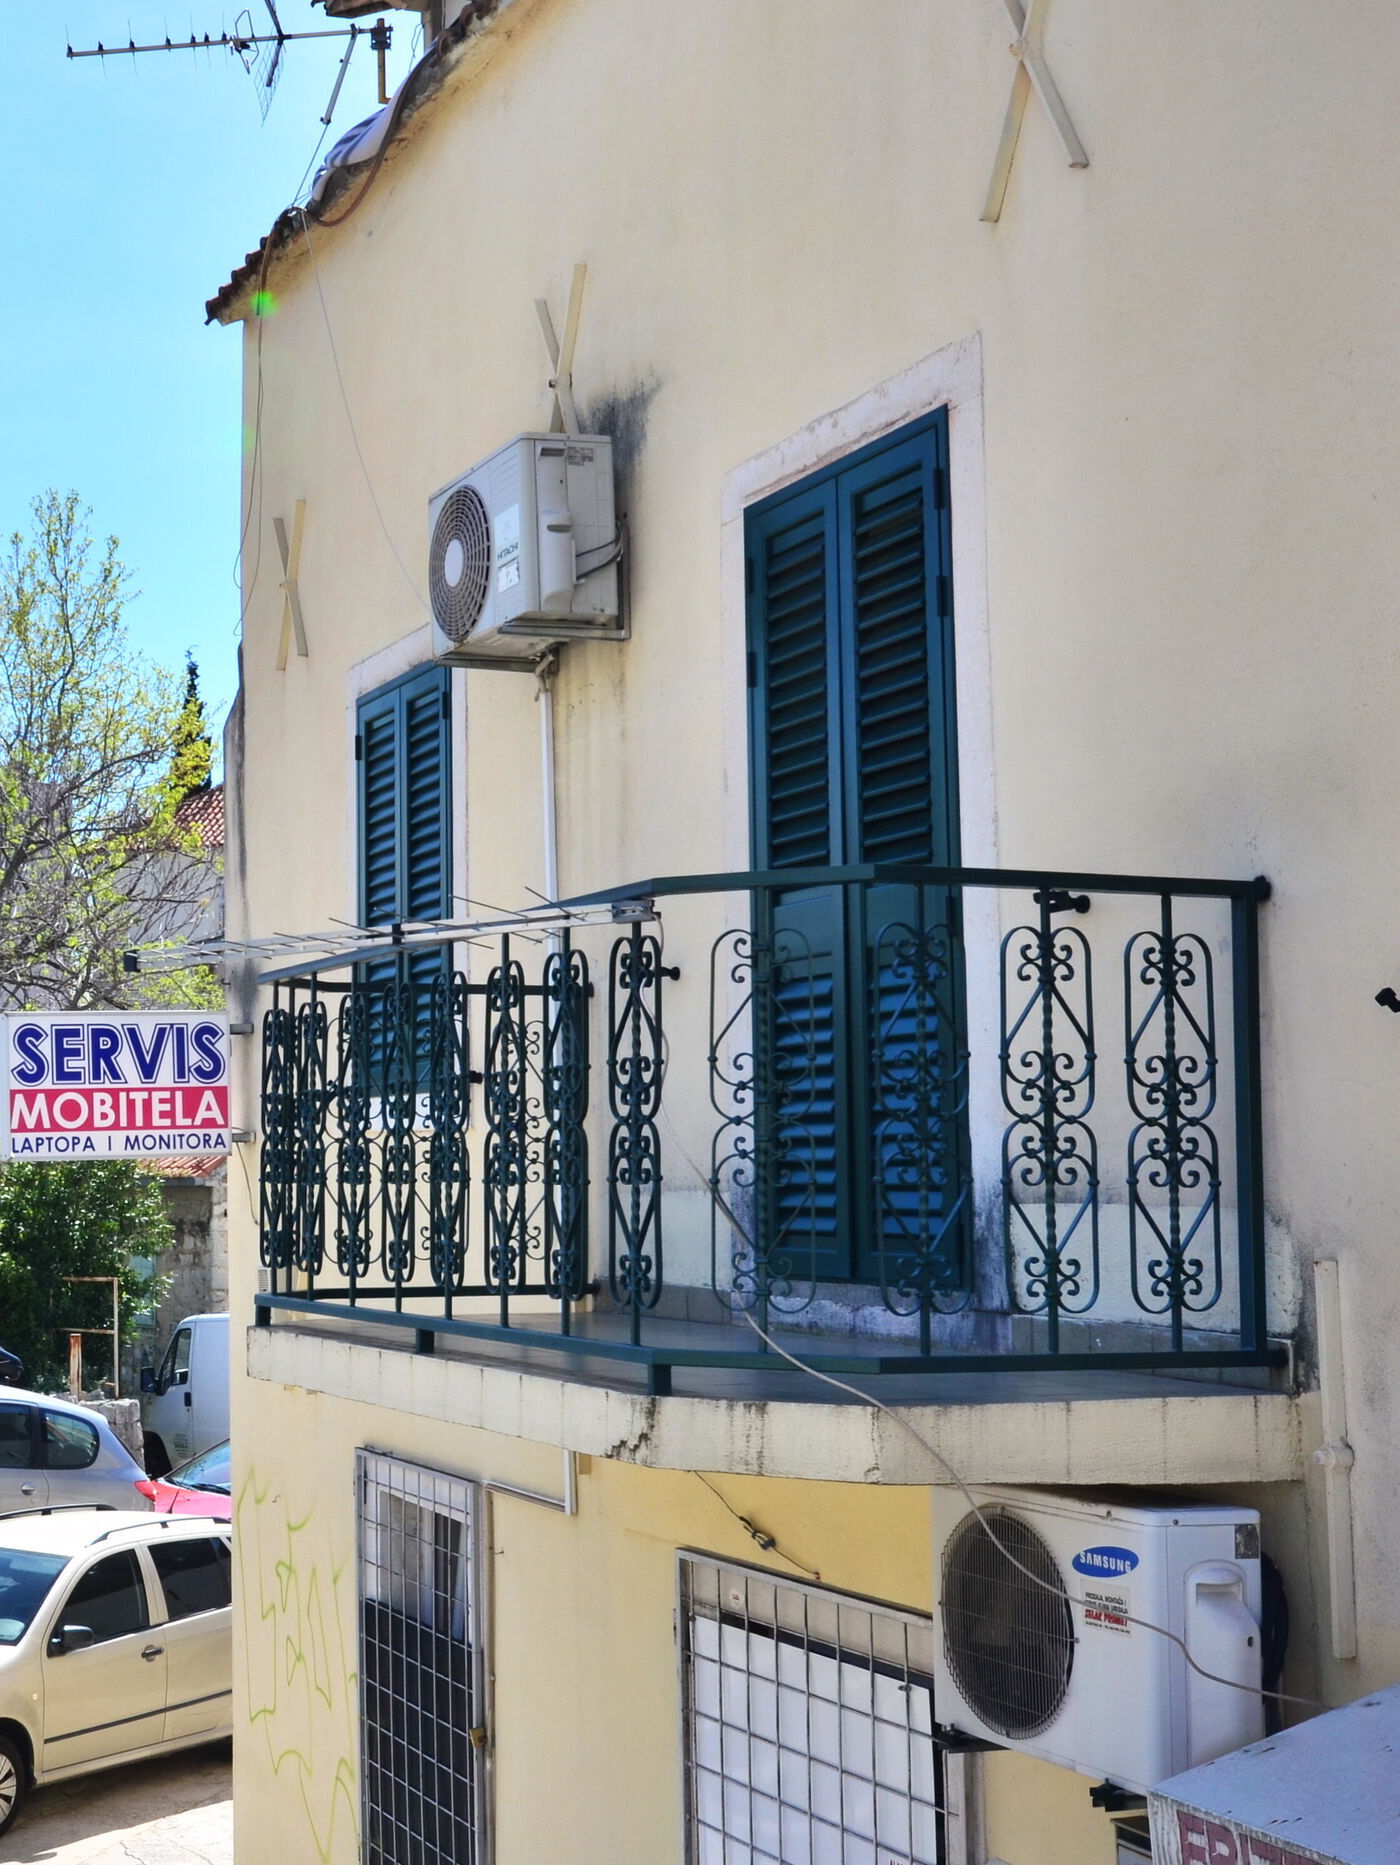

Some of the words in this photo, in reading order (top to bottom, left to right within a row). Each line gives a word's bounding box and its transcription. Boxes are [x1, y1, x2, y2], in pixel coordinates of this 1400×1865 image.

[11, 1022, 226, 1087] SERVIS
[11, 1090, 225, 1129] MOBITELA
[11, 1136, 96, 1153] LAPTOPA
[108, 1136, 112, 1151] I
[124, 1133, 227, 1151] MONITORA
[1080, 1551, 1132, 1573] SAMSUNG
